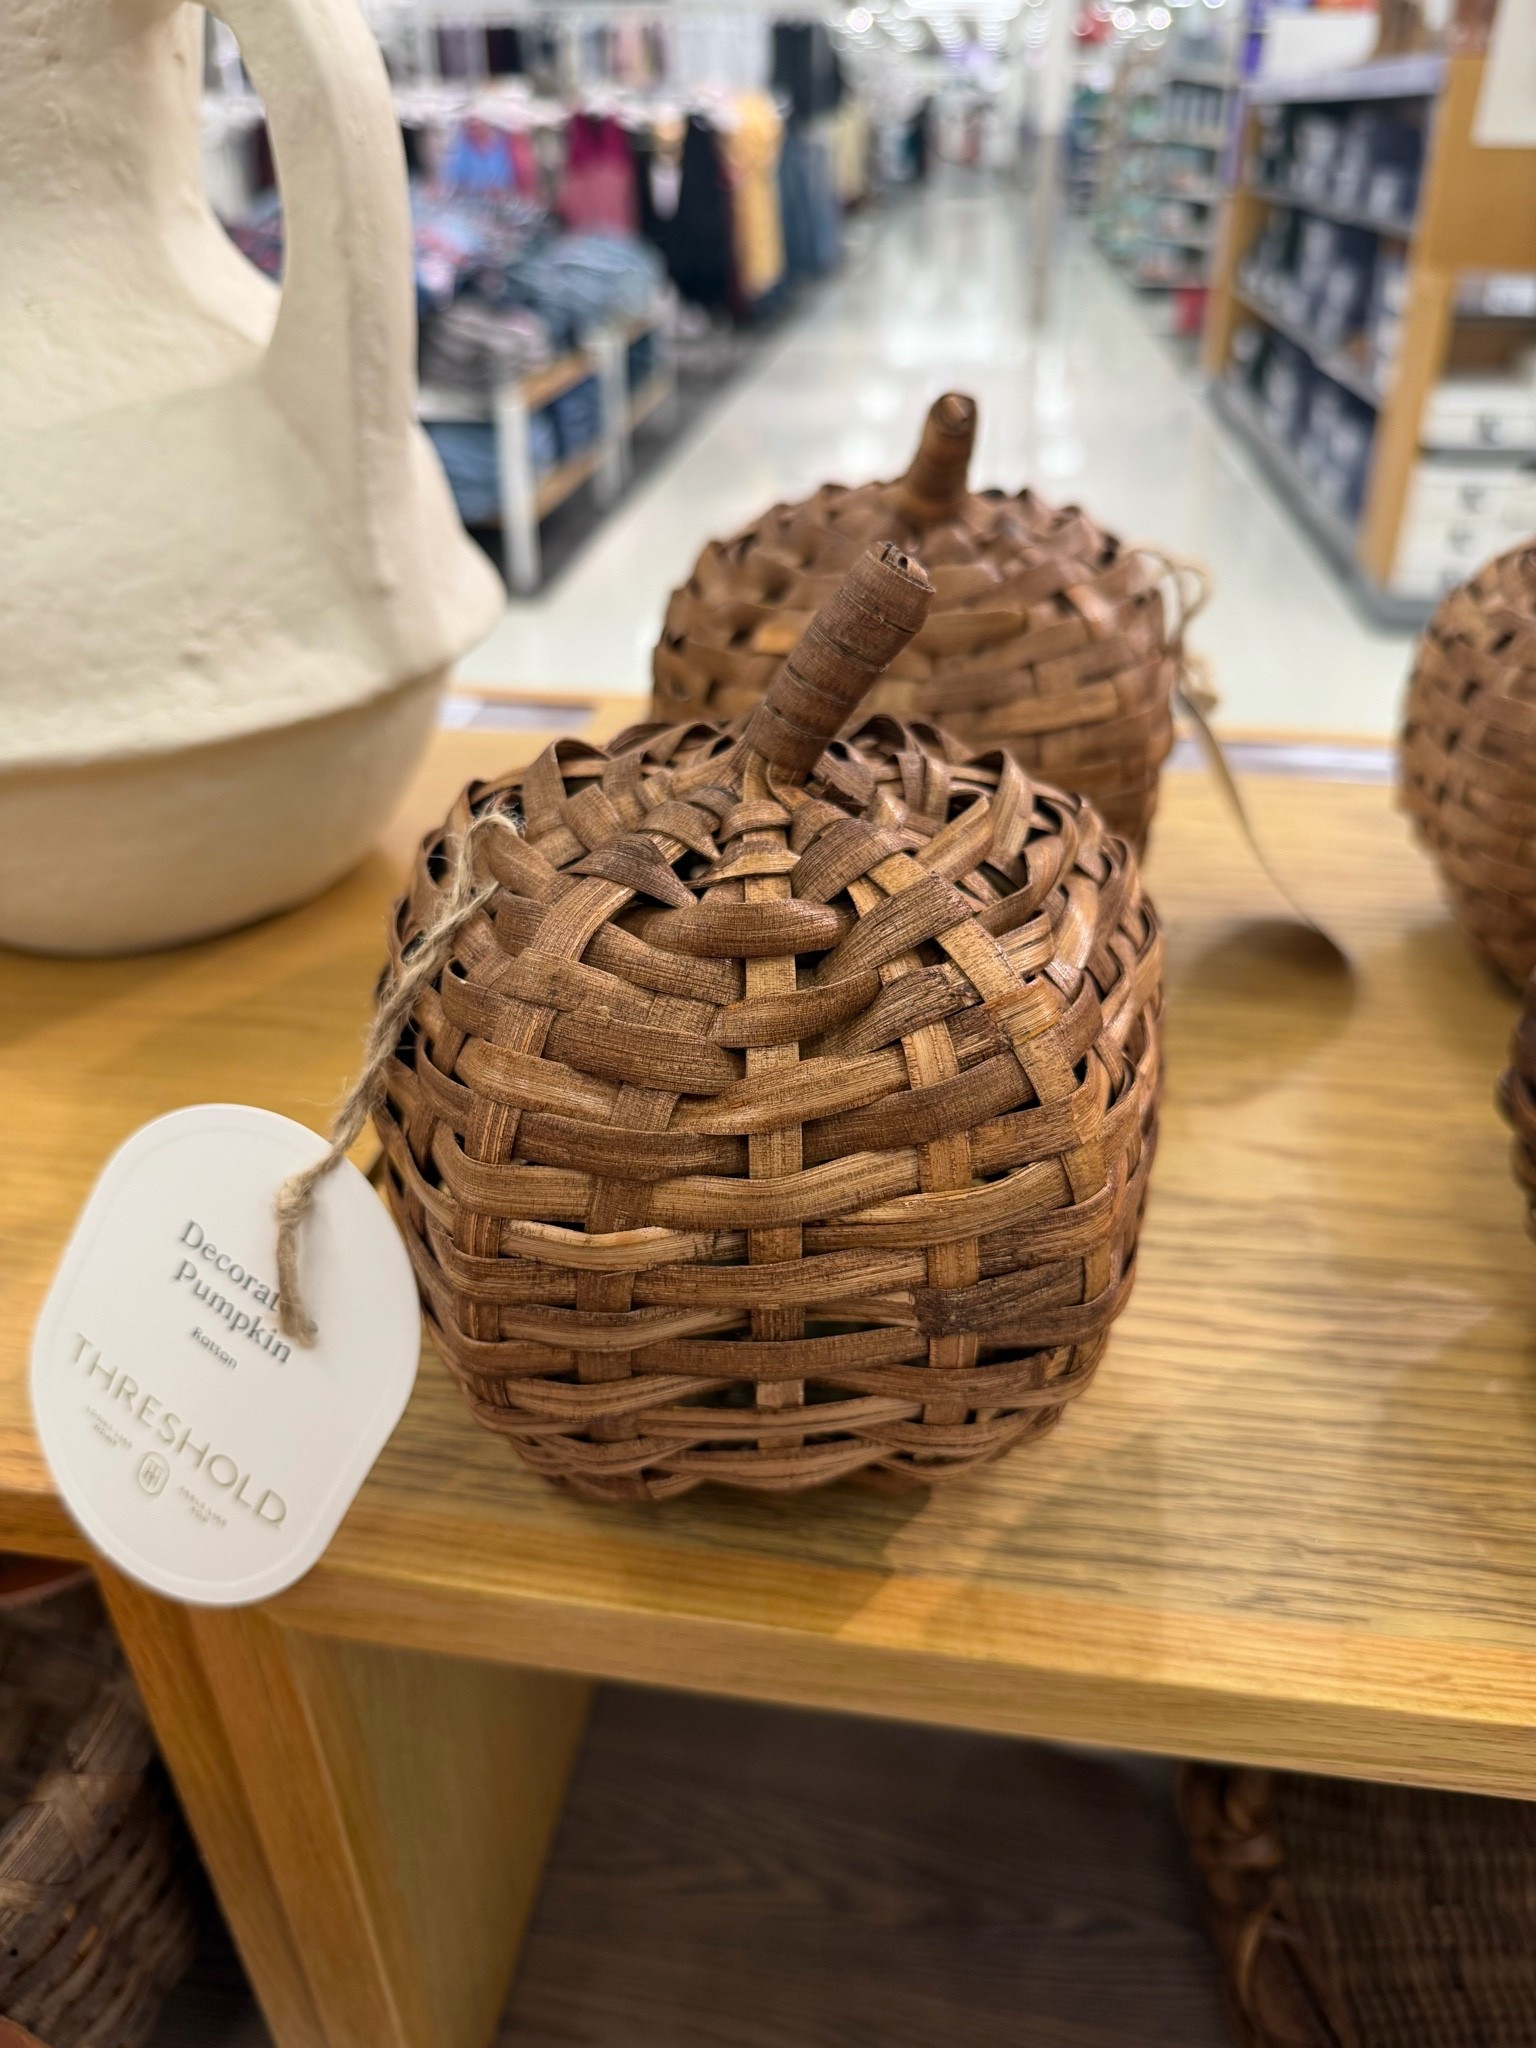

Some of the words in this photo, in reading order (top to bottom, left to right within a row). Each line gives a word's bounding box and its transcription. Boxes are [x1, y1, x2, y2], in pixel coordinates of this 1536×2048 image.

[174, 1259, 292, 1364] Pumpkin
[178, 1219, 318, 1333] Decorat
[71, 1331, 288, 1529] THRESHOLD
